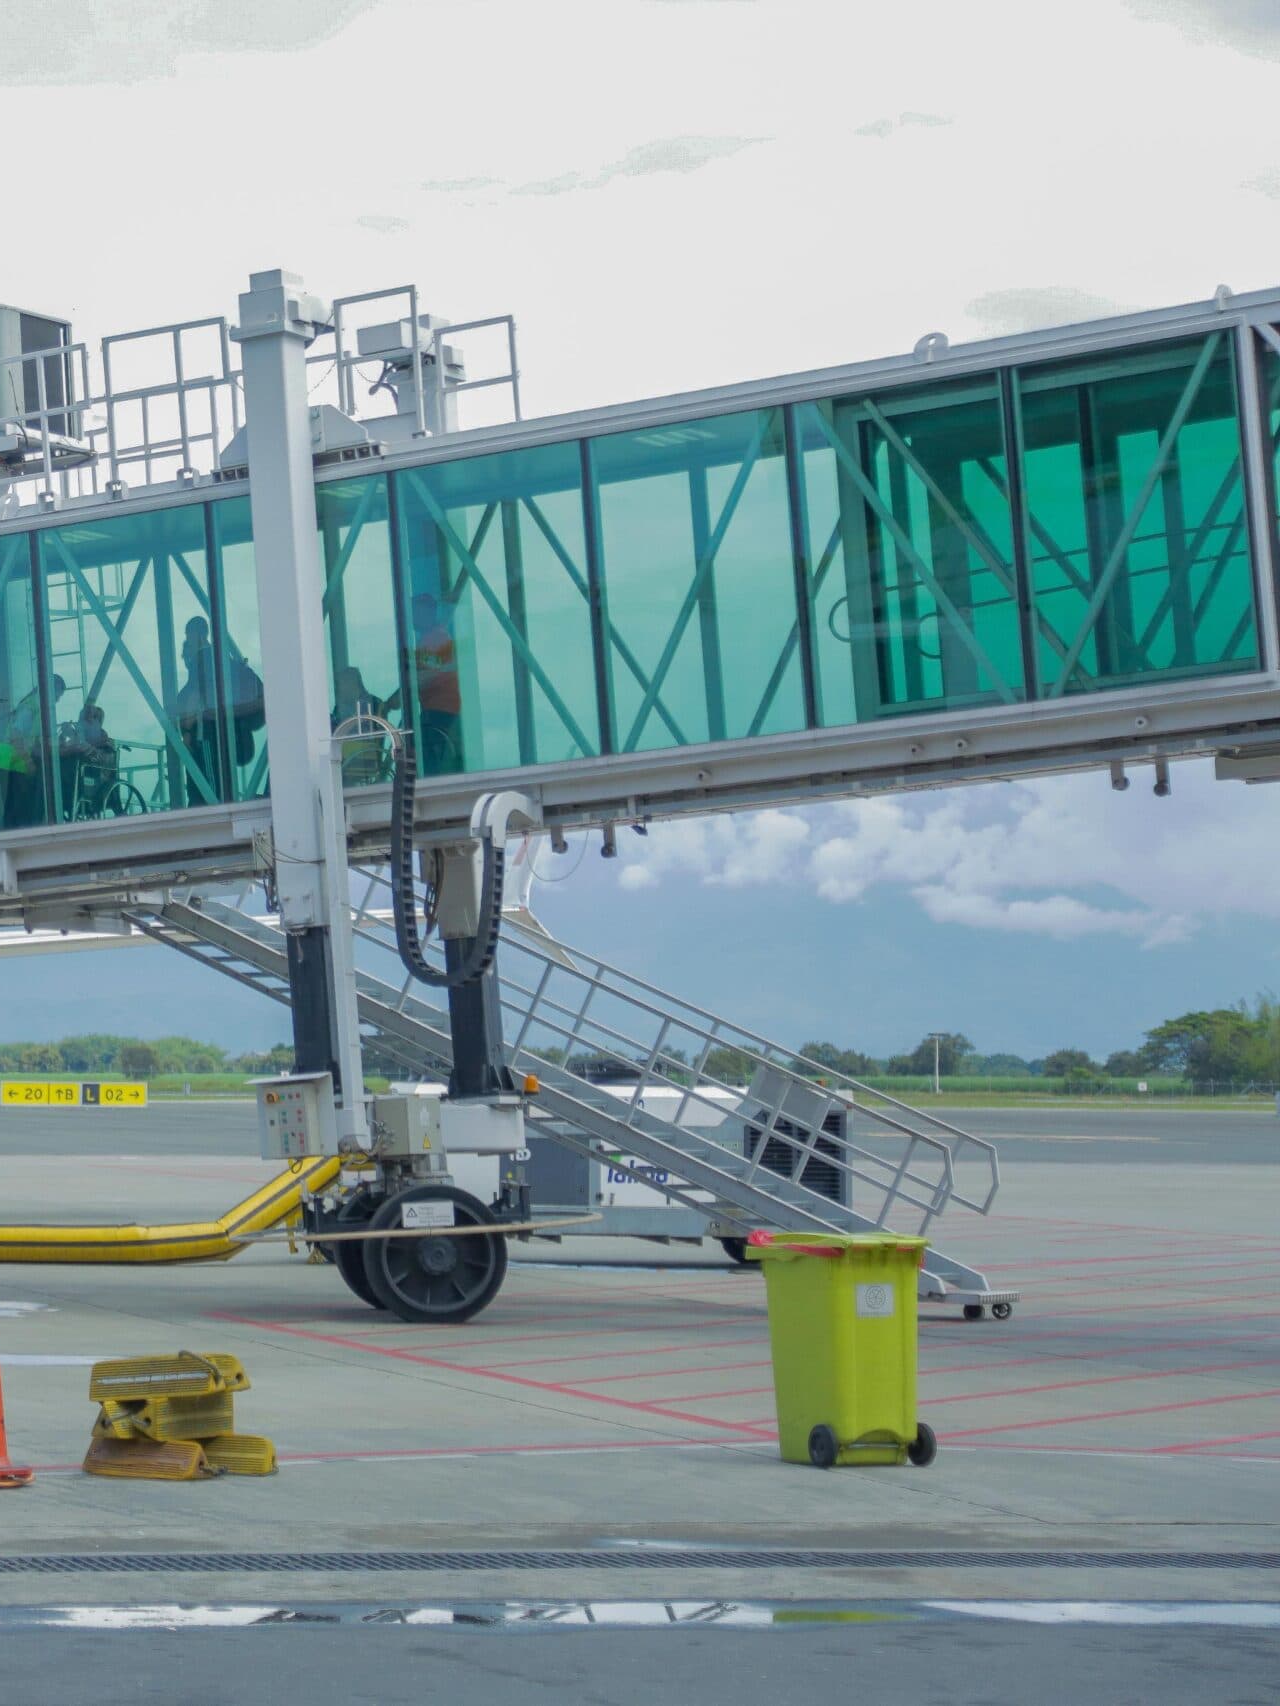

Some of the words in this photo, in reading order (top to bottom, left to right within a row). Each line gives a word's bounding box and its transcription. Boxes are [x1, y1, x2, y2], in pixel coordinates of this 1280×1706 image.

[24, 1087, 43, 1101] 20
[65, 1088, 74, 1101] B
[86, 1087, 95, 1102] L
[105, 1088, 124, 1101] 02
